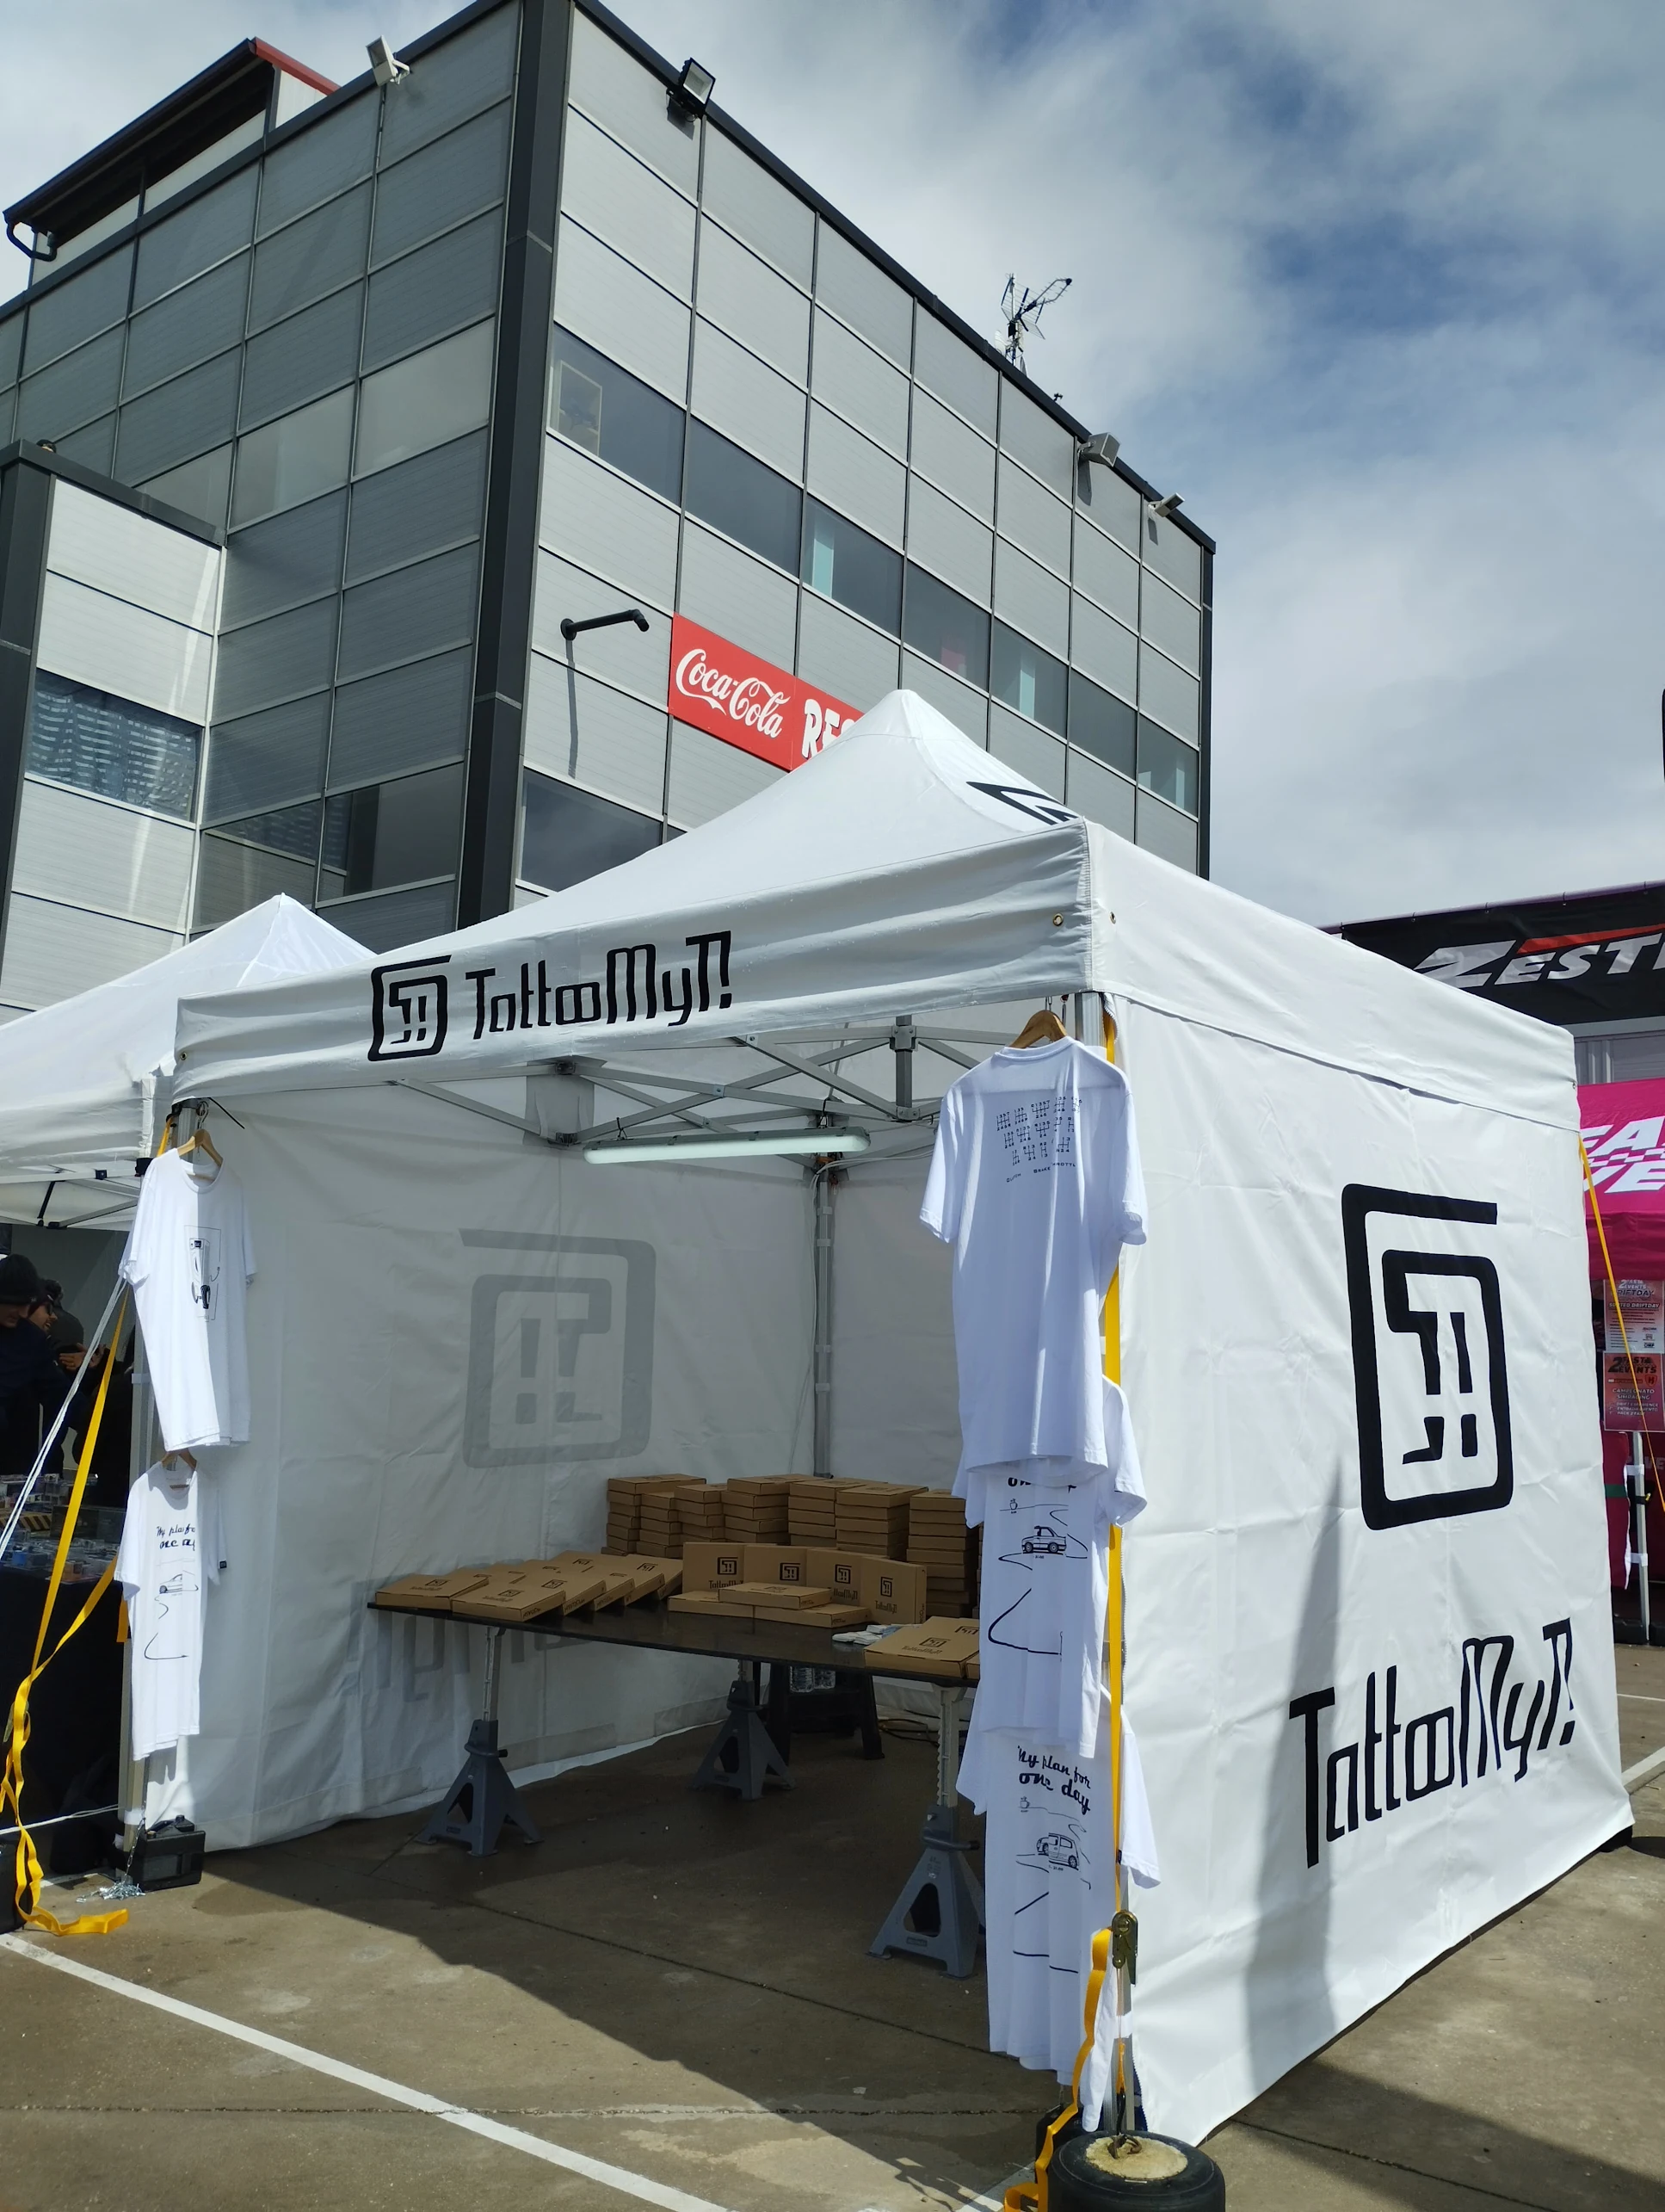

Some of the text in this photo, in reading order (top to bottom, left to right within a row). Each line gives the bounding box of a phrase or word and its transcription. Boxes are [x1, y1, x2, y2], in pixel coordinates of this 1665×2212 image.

[675, 648, 791, 738] Coca-Cola
[1042, 1755, 1070, 1776] plan
[1061, 1778, 1091, 1815] day
